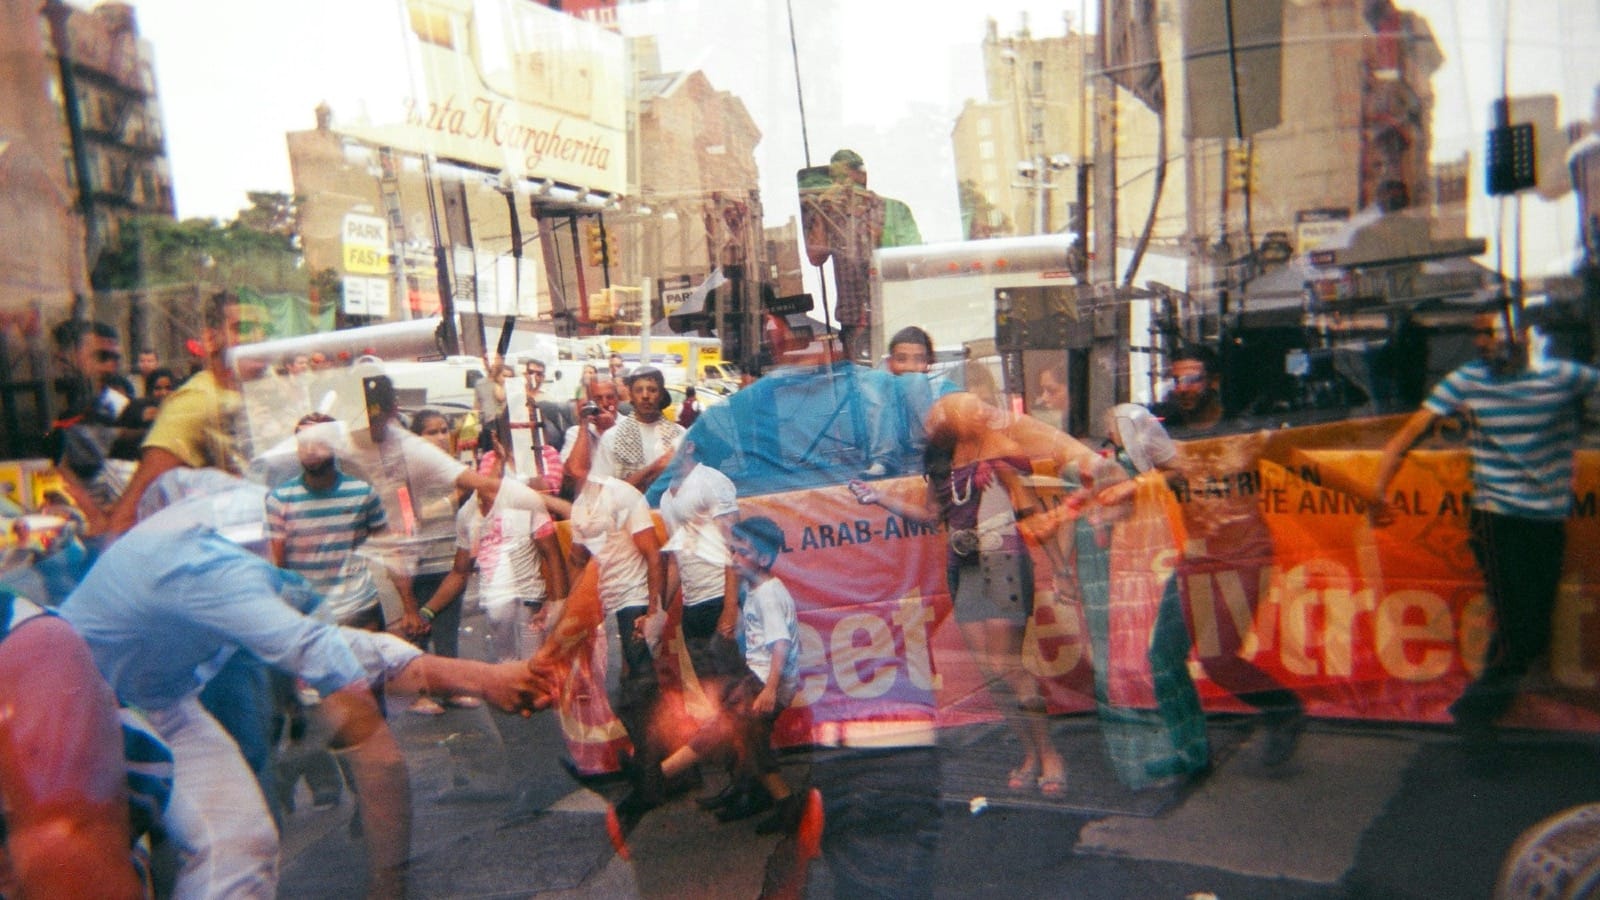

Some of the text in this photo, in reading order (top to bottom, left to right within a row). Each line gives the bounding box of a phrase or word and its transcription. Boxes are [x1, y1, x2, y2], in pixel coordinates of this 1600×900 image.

[465, 97, 611, 171] Margherita
[348, 221, 383, 241] PARK
[349, 249, 382, 266] FAST
[666, 291, 694, 305] PAR
[1299, 489, 1429, 516] ANNAL
